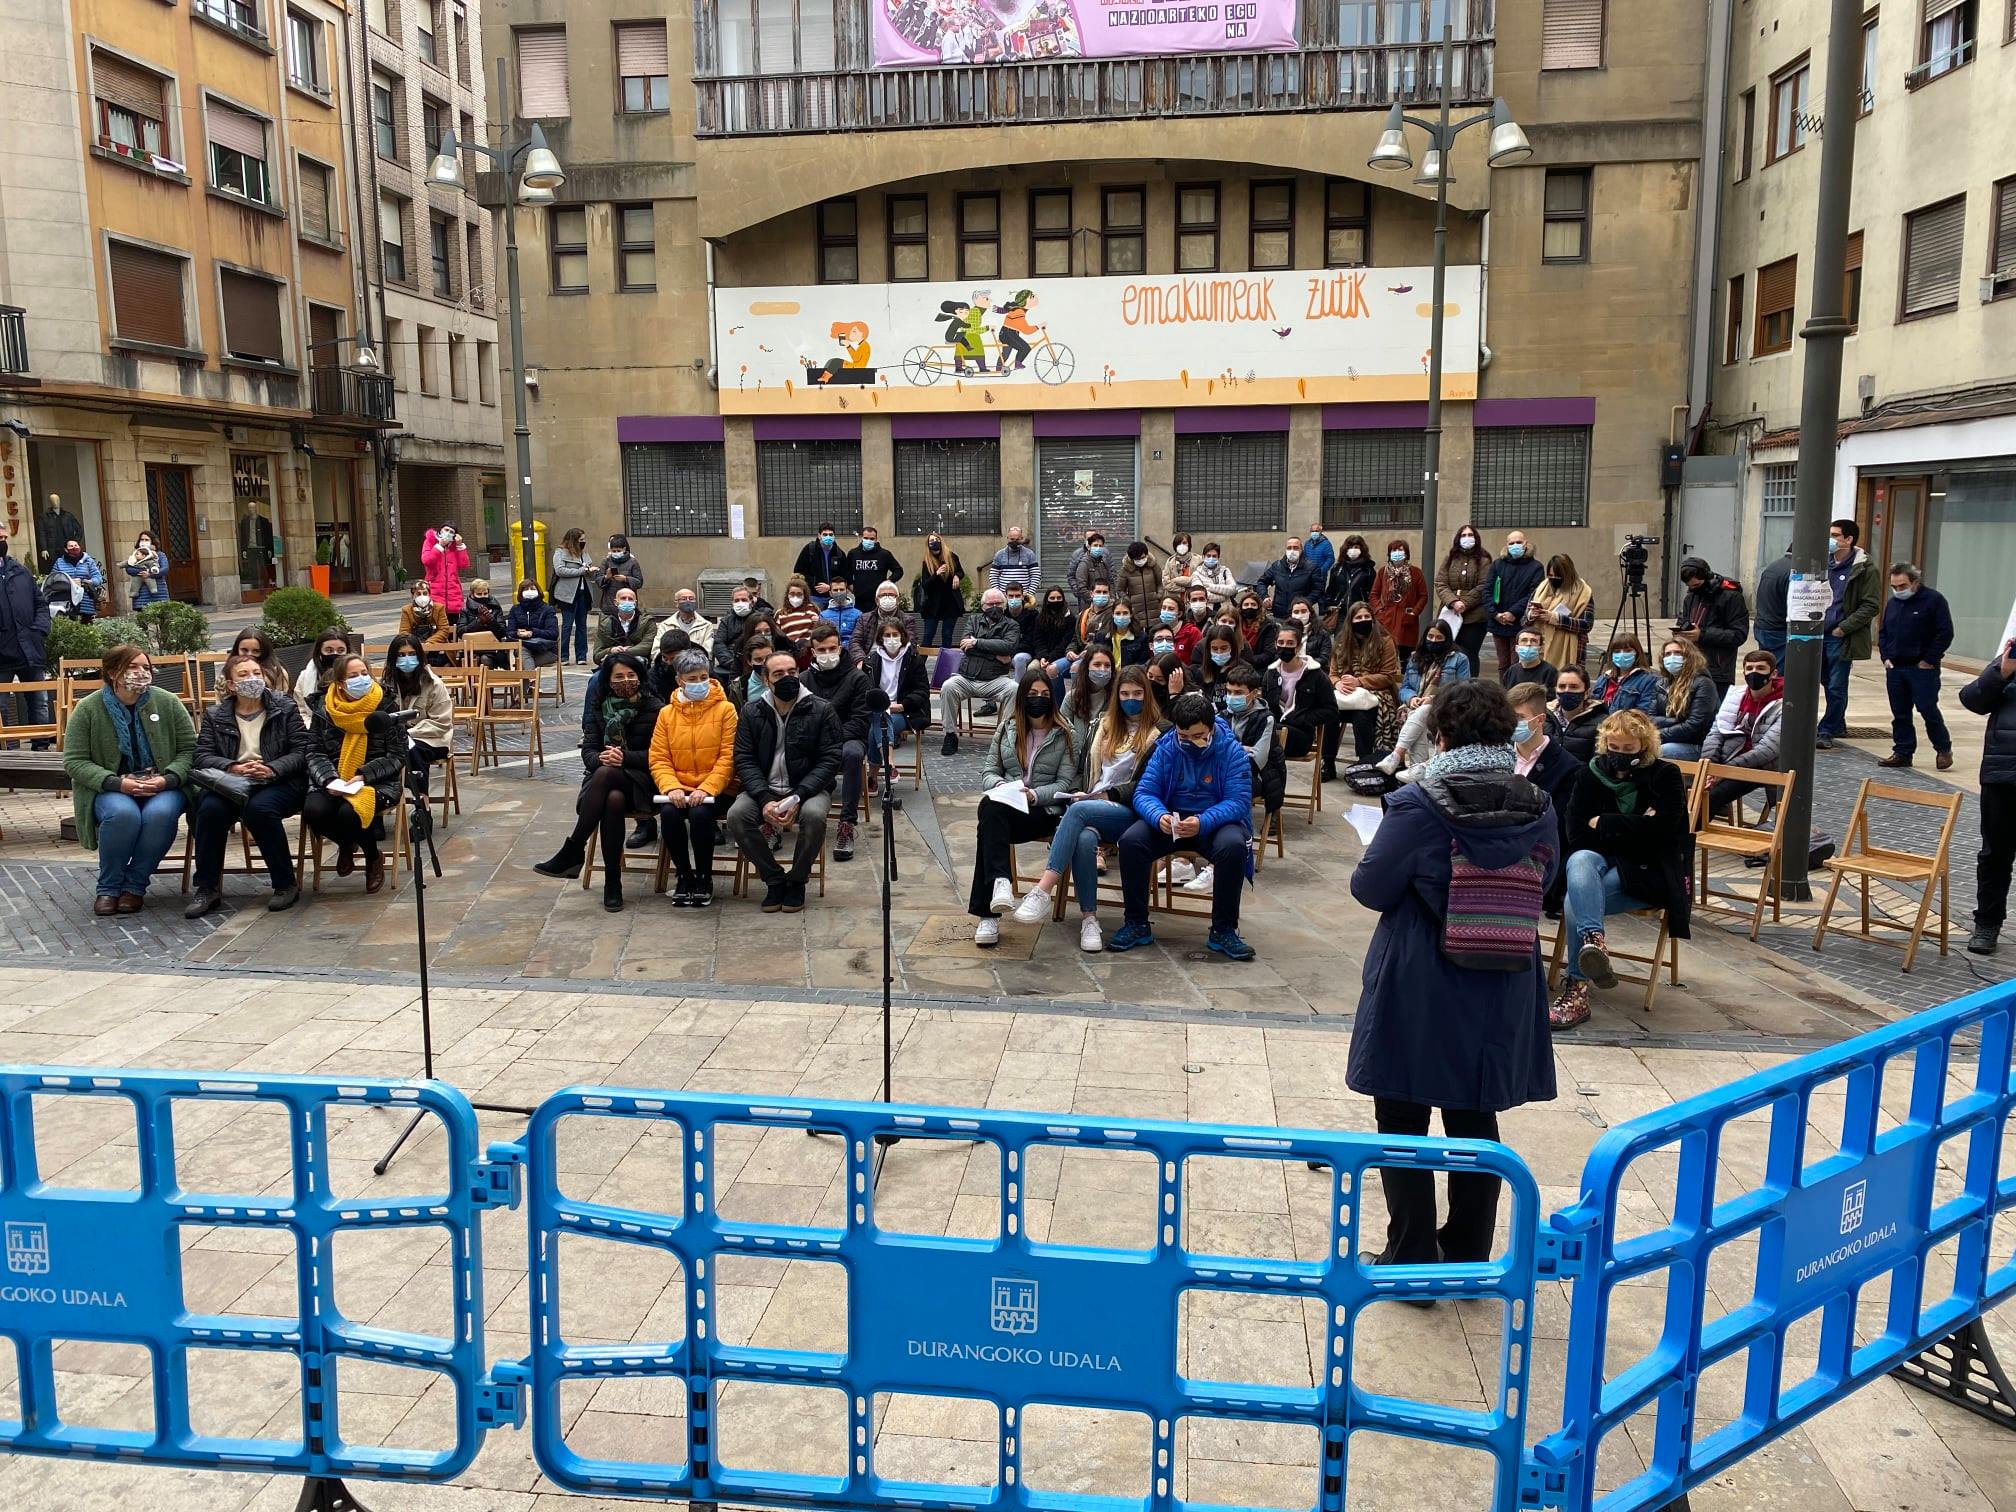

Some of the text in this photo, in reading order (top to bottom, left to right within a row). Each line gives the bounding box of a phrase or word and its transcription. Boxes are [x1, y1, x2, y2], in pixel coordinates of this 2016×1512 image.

[1109, 3, 1256, 27] NAZIOARTEKO EGU
[1226, 22, 1247, 38] NA
[236, 455, 257, 475] ACT
[233, 476, 262, 497] NOW
[1796, 1222, 1897, 1283] DURANGOKO UDALA
[0, 1286, 128, 1308] GOKO UDALA
[907, 1340, 1122, 1372] DURANGOKO UDALA
